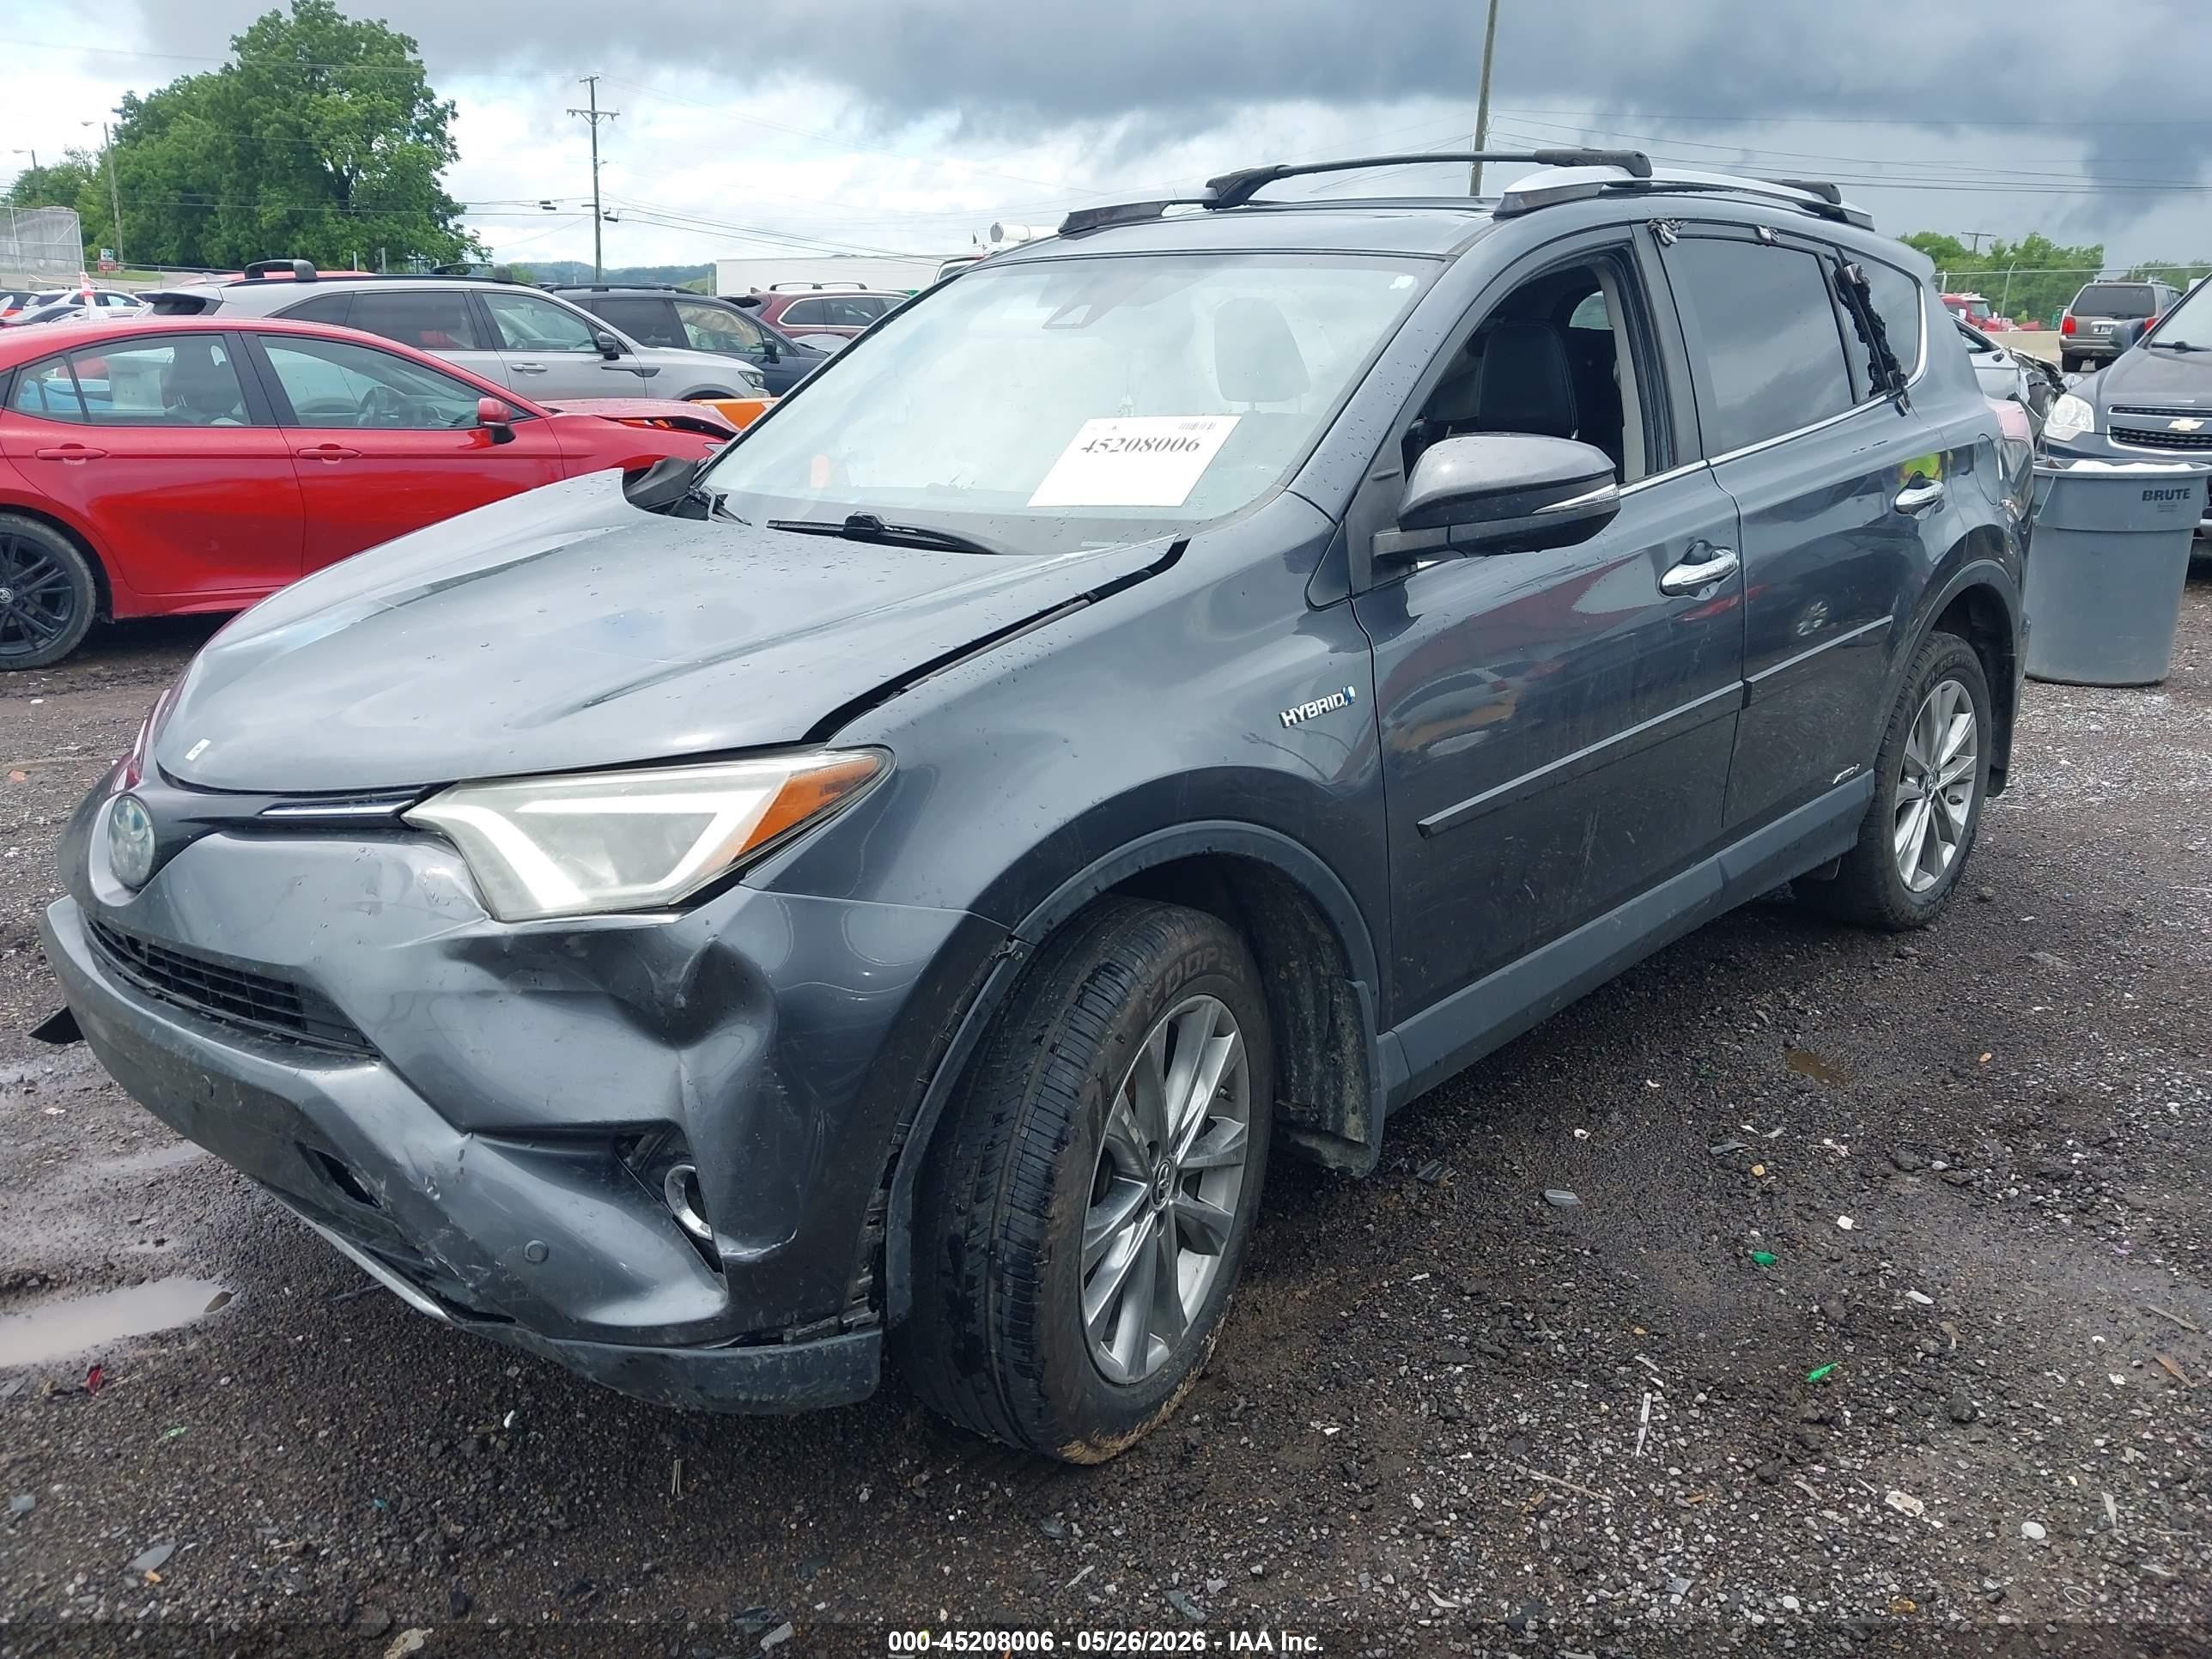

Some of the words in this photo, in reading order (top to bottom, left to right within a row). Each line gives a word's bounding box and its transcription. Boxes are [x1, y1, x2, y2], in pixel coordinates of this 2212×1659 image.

[1080, 436, 1202, 453] 45208006
[2142, 488, 2191, 501] BRUTE
[1279, 693, 1346, 728] HYBRID
